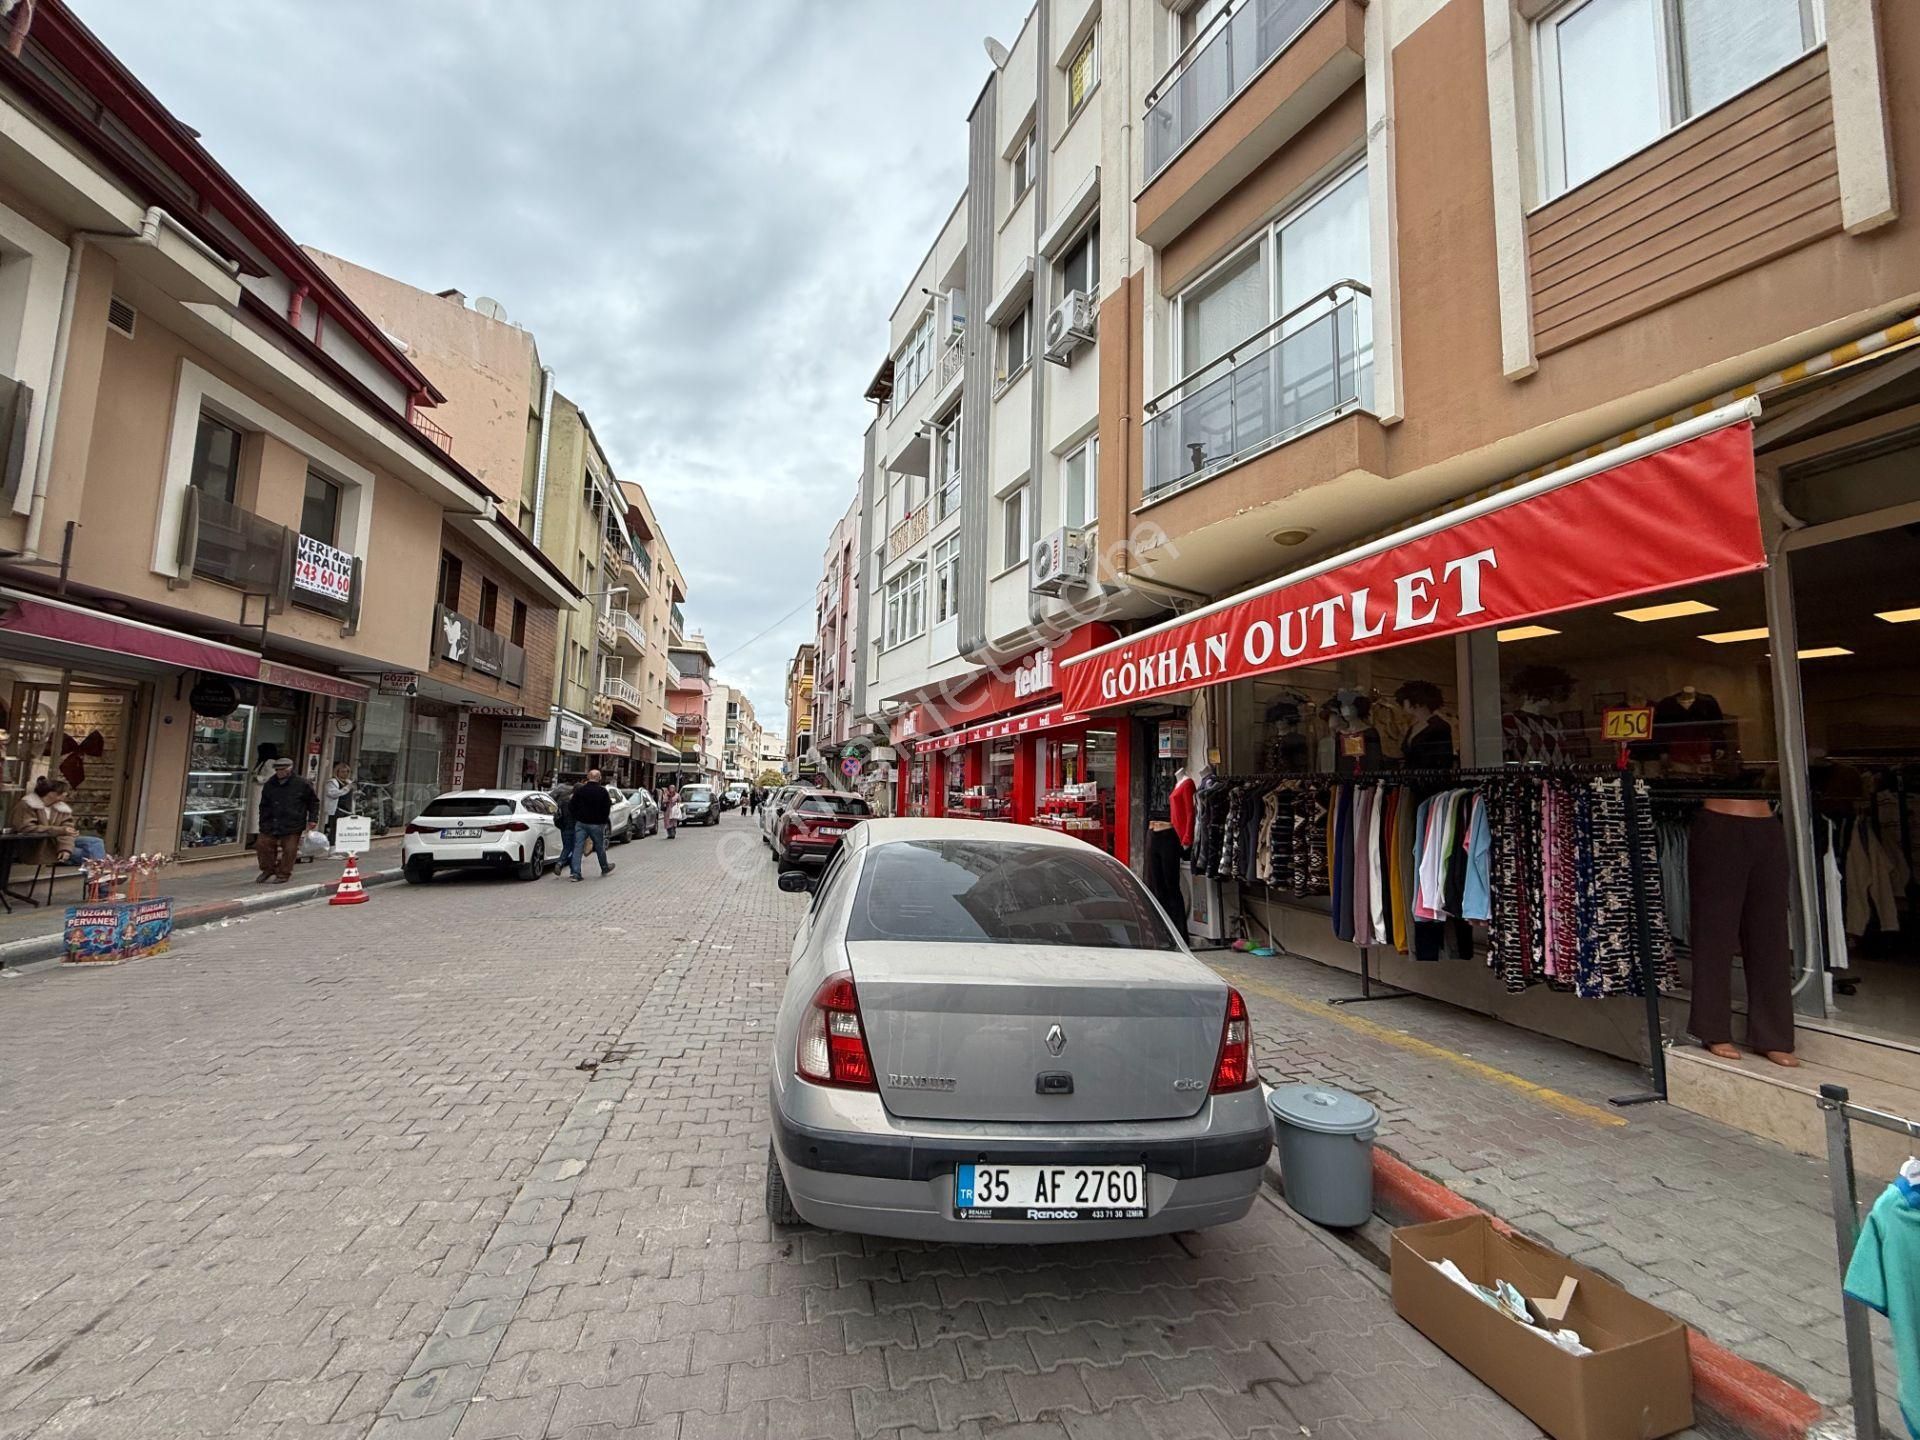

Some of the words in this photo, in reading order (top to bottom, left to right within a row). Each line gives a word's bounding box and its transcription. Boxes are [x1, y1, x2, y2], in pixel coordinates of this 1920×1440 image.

[296, 561, 316, 581] 743
[321, 570, 334, 588] 60
[337, 576, 349, 593] 60
[1101, 632, 1228, 700] GÖKHAN
[1243, 548, 1498, 666] OUTLET
[383, 673, 416, 682] GÖZDE
[1608, 712, 1649, 736] 150
[453, 721, 467, 786] PERDE
[887, 1073, 956, 1091] RENAULT
[961, 1189, 973, 1199] TR
[978, 1169, 1009, 1203] 35
[1034, 1169, 1066, 1203] AF
[1074, 1169, 1138, 1204] 2760
[1027, 1209, 1078, 1220] Renoto
[1092, 1210, 1104, 1218] 433
[1105, 1210, 1113, 1218] 71
[1114, 1210, 1123, 1218] 30
